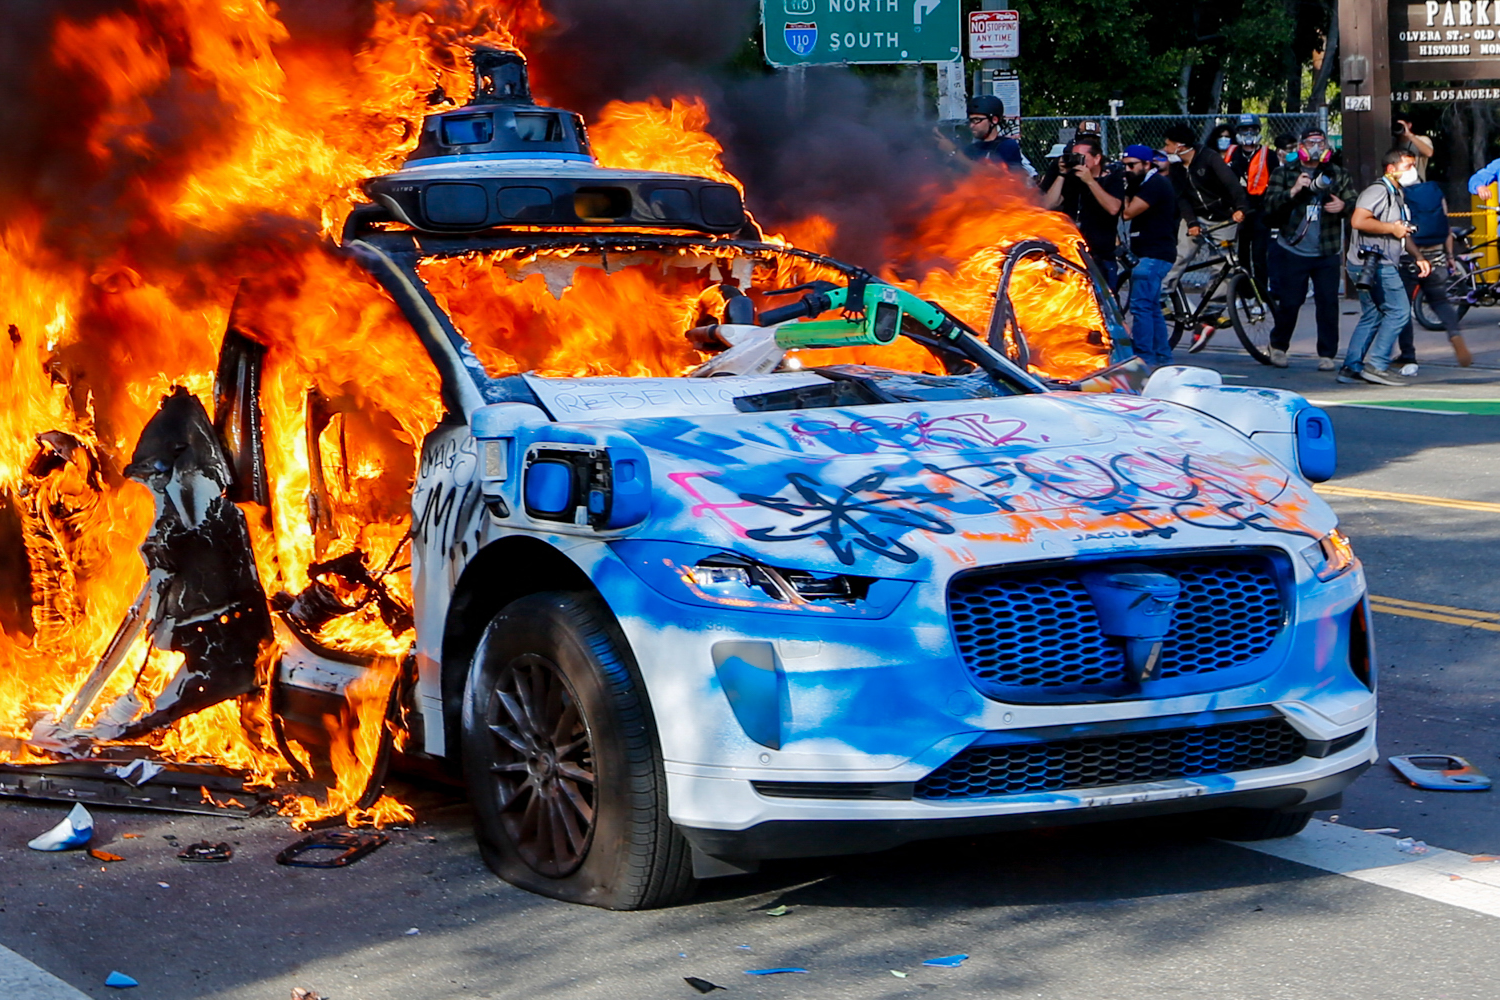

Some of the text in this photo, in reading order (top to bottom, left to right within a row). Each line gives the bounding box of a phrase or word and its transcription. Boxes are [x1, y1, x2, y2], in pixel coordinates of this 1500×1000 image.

[971, 21, 1017, 32] NO STOPPING
[792, 32, 898, 48] 110 SOUTH
[976, 33, 1012, 42] ANY TIME
[1399, 30, 1442, 41] OLVERA
[1474, 29, 1495, 40] OLD
[1419, 44, 1470, 55] HISTORIC
[1415, 90, 1427, 100] N.
[924, 453, 1289, 512] FUCK
[1102, 501, 1316, 540] ICE
